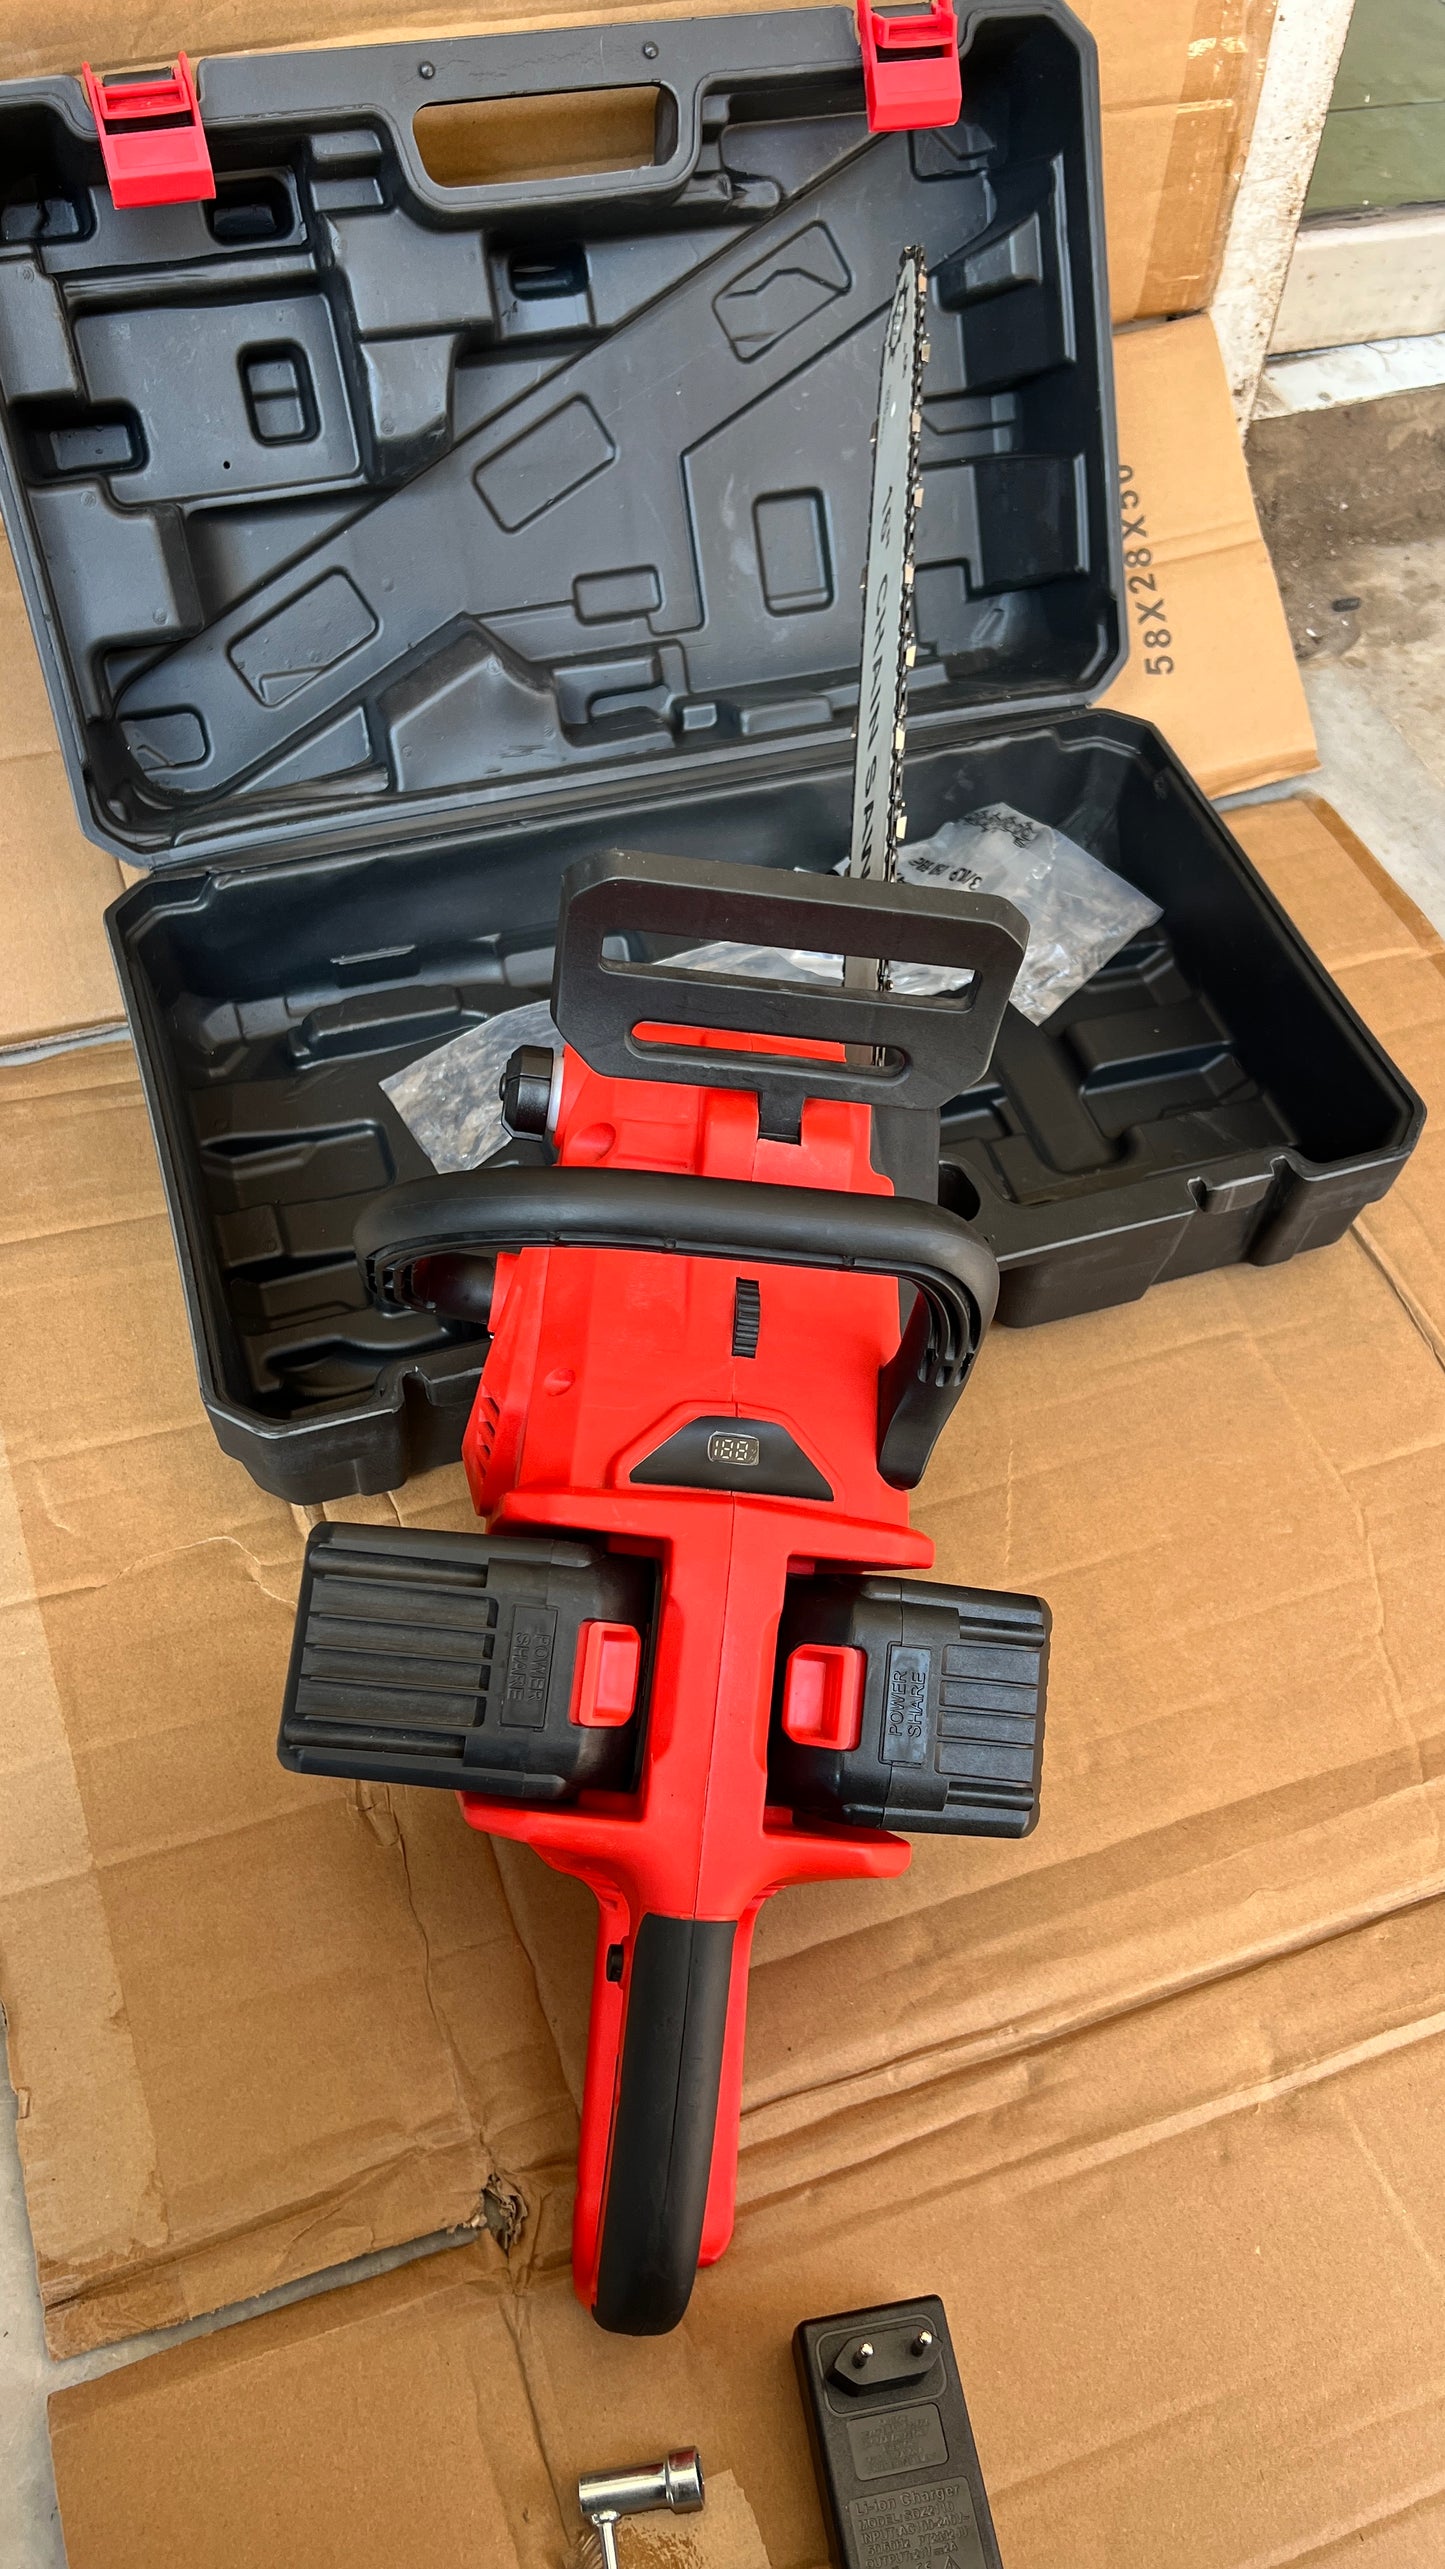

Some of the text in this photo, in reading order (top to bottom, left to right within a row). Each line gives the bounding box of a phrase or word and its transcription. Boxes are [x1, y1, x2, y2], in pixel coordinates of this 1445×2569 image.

[867, 573, 888, 752] CHAIN
[506, 1632, 531, 1701] SHARE
[528, 1632, 551, 1702] POWER
[888, 1670, 908, 1737] POWER
[908, 1672, 926, 1738] SHARE
[856, 2485, 960, 2516] Li-ion Charger
